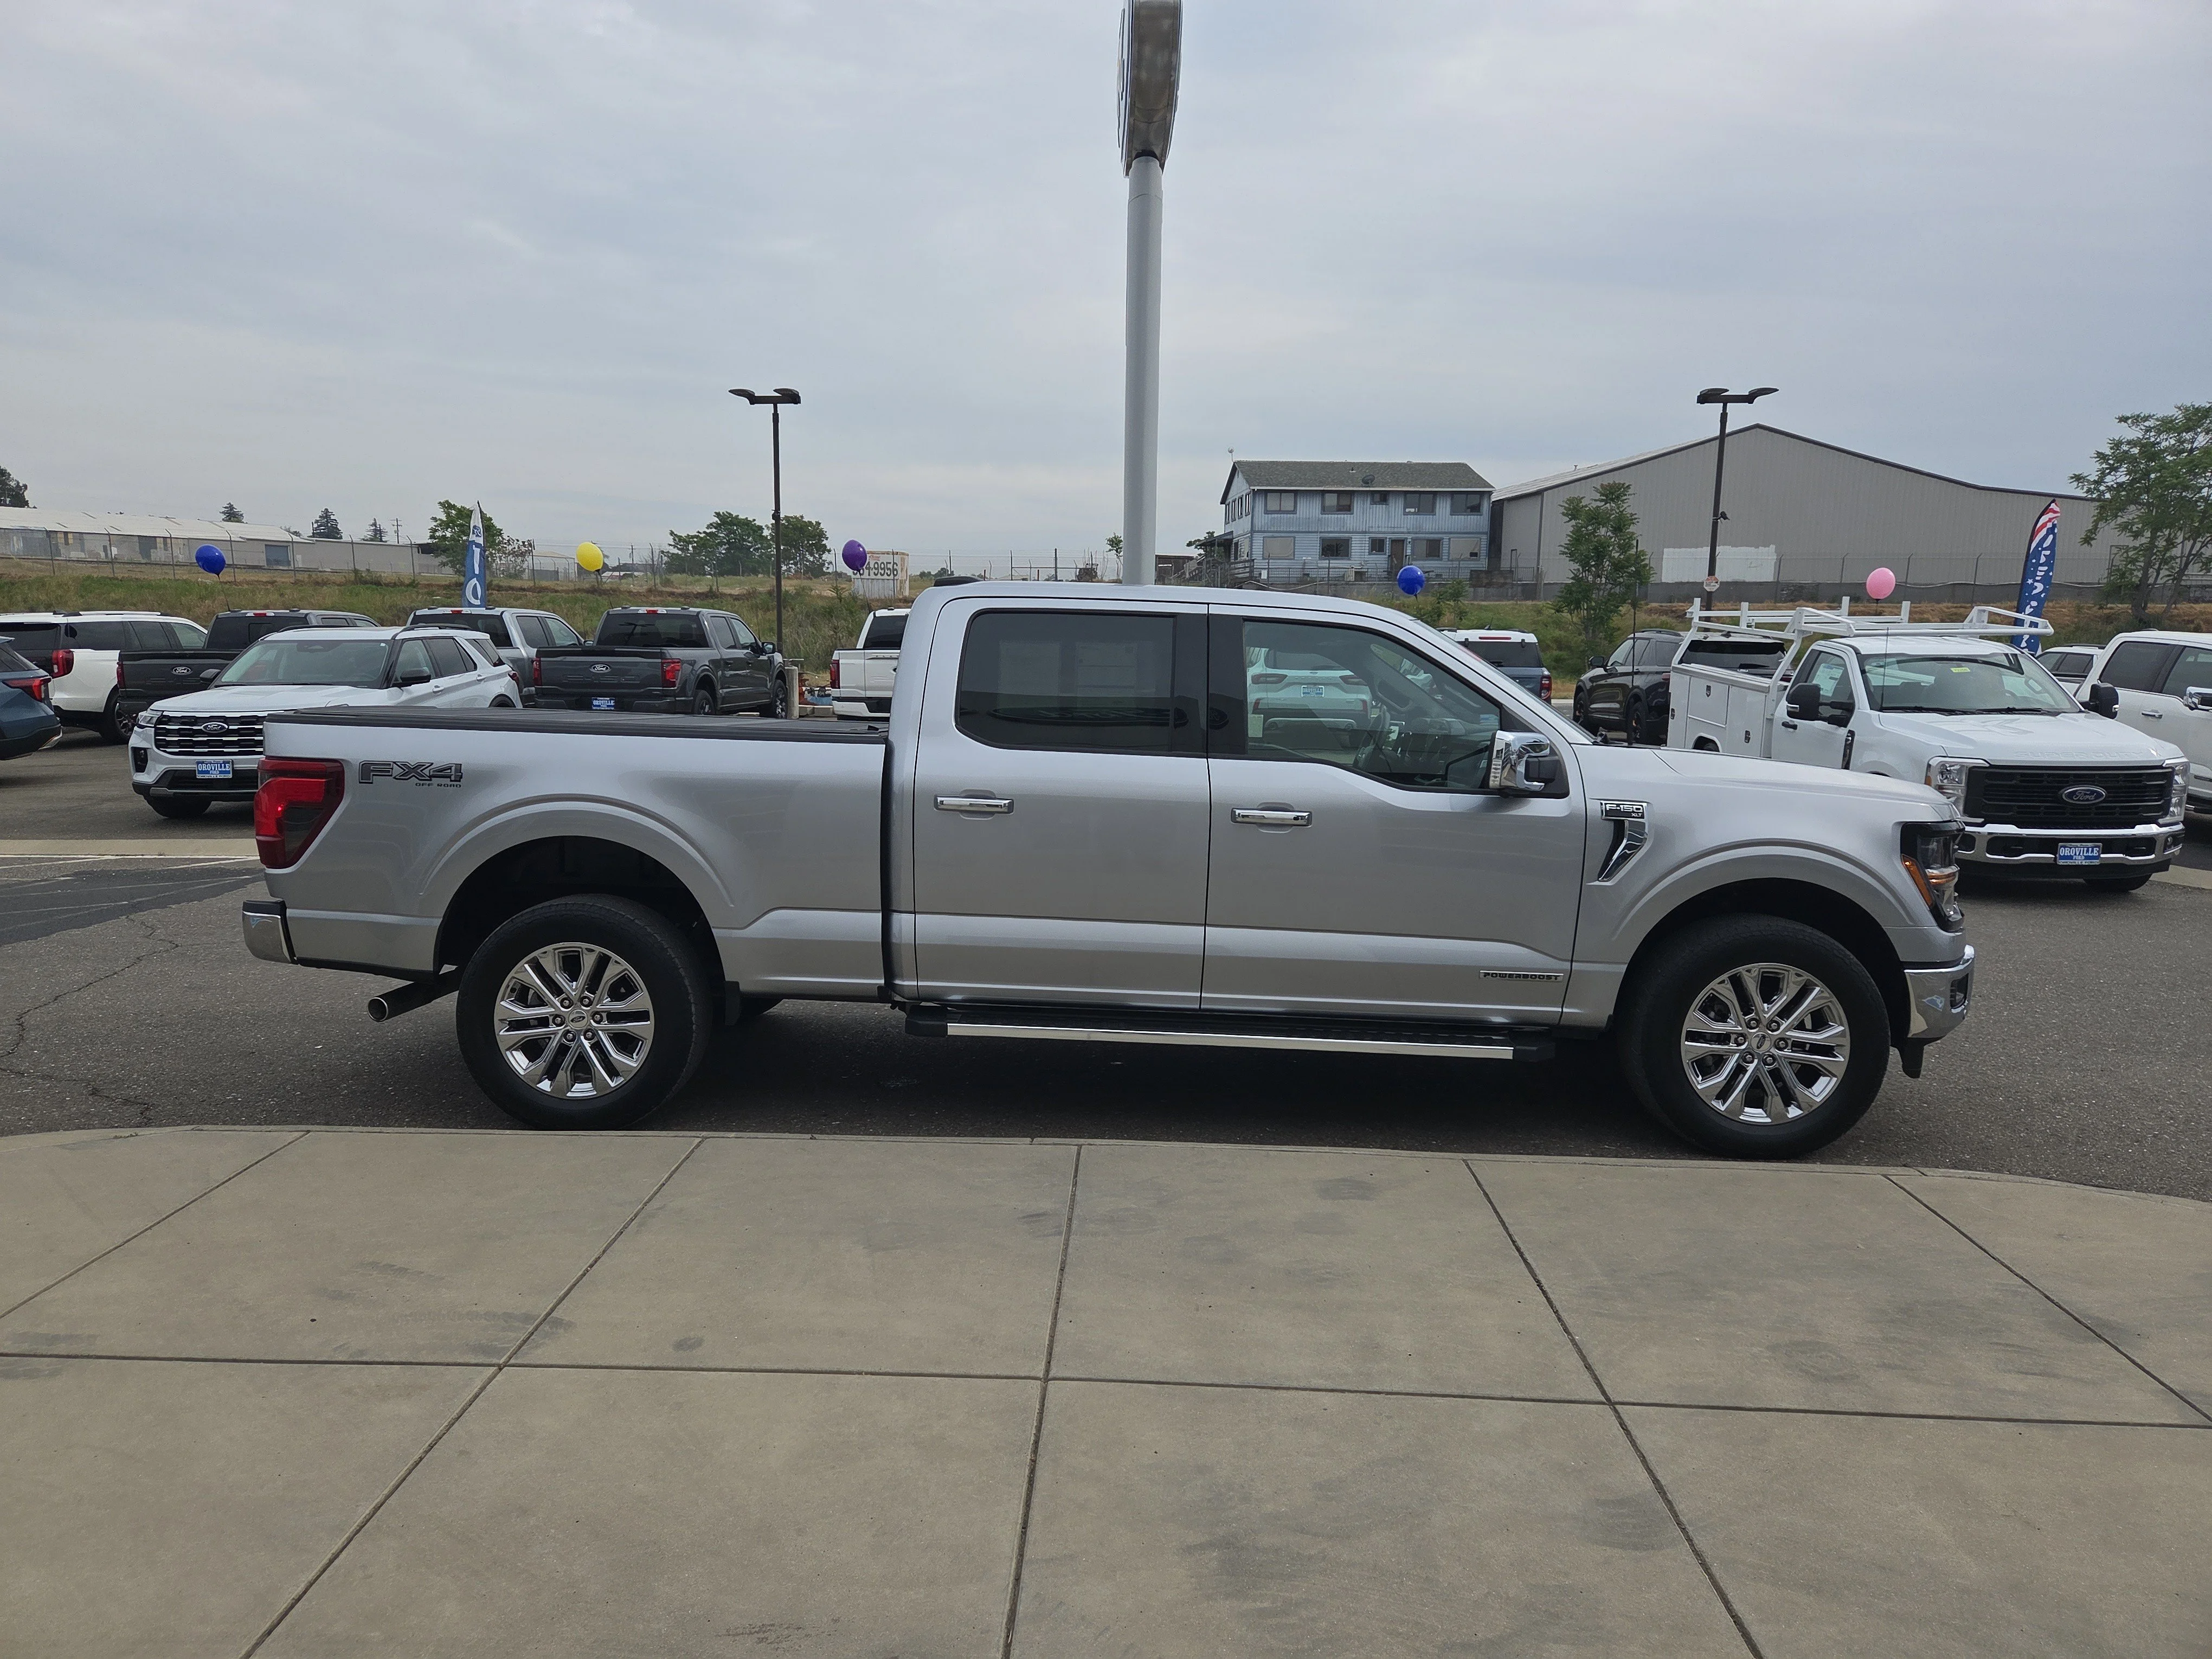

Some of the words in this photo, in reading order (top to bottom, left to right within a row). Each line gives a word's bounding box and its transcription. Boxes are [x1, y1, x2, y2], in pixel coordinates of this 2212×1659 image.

[359, 761, 462, 783] FX4
[2073, 790, 2095, 800] Ford
[1606, 804, 1643, 812] F-150
[2060, 847, 2099, 856] OROVILLE
